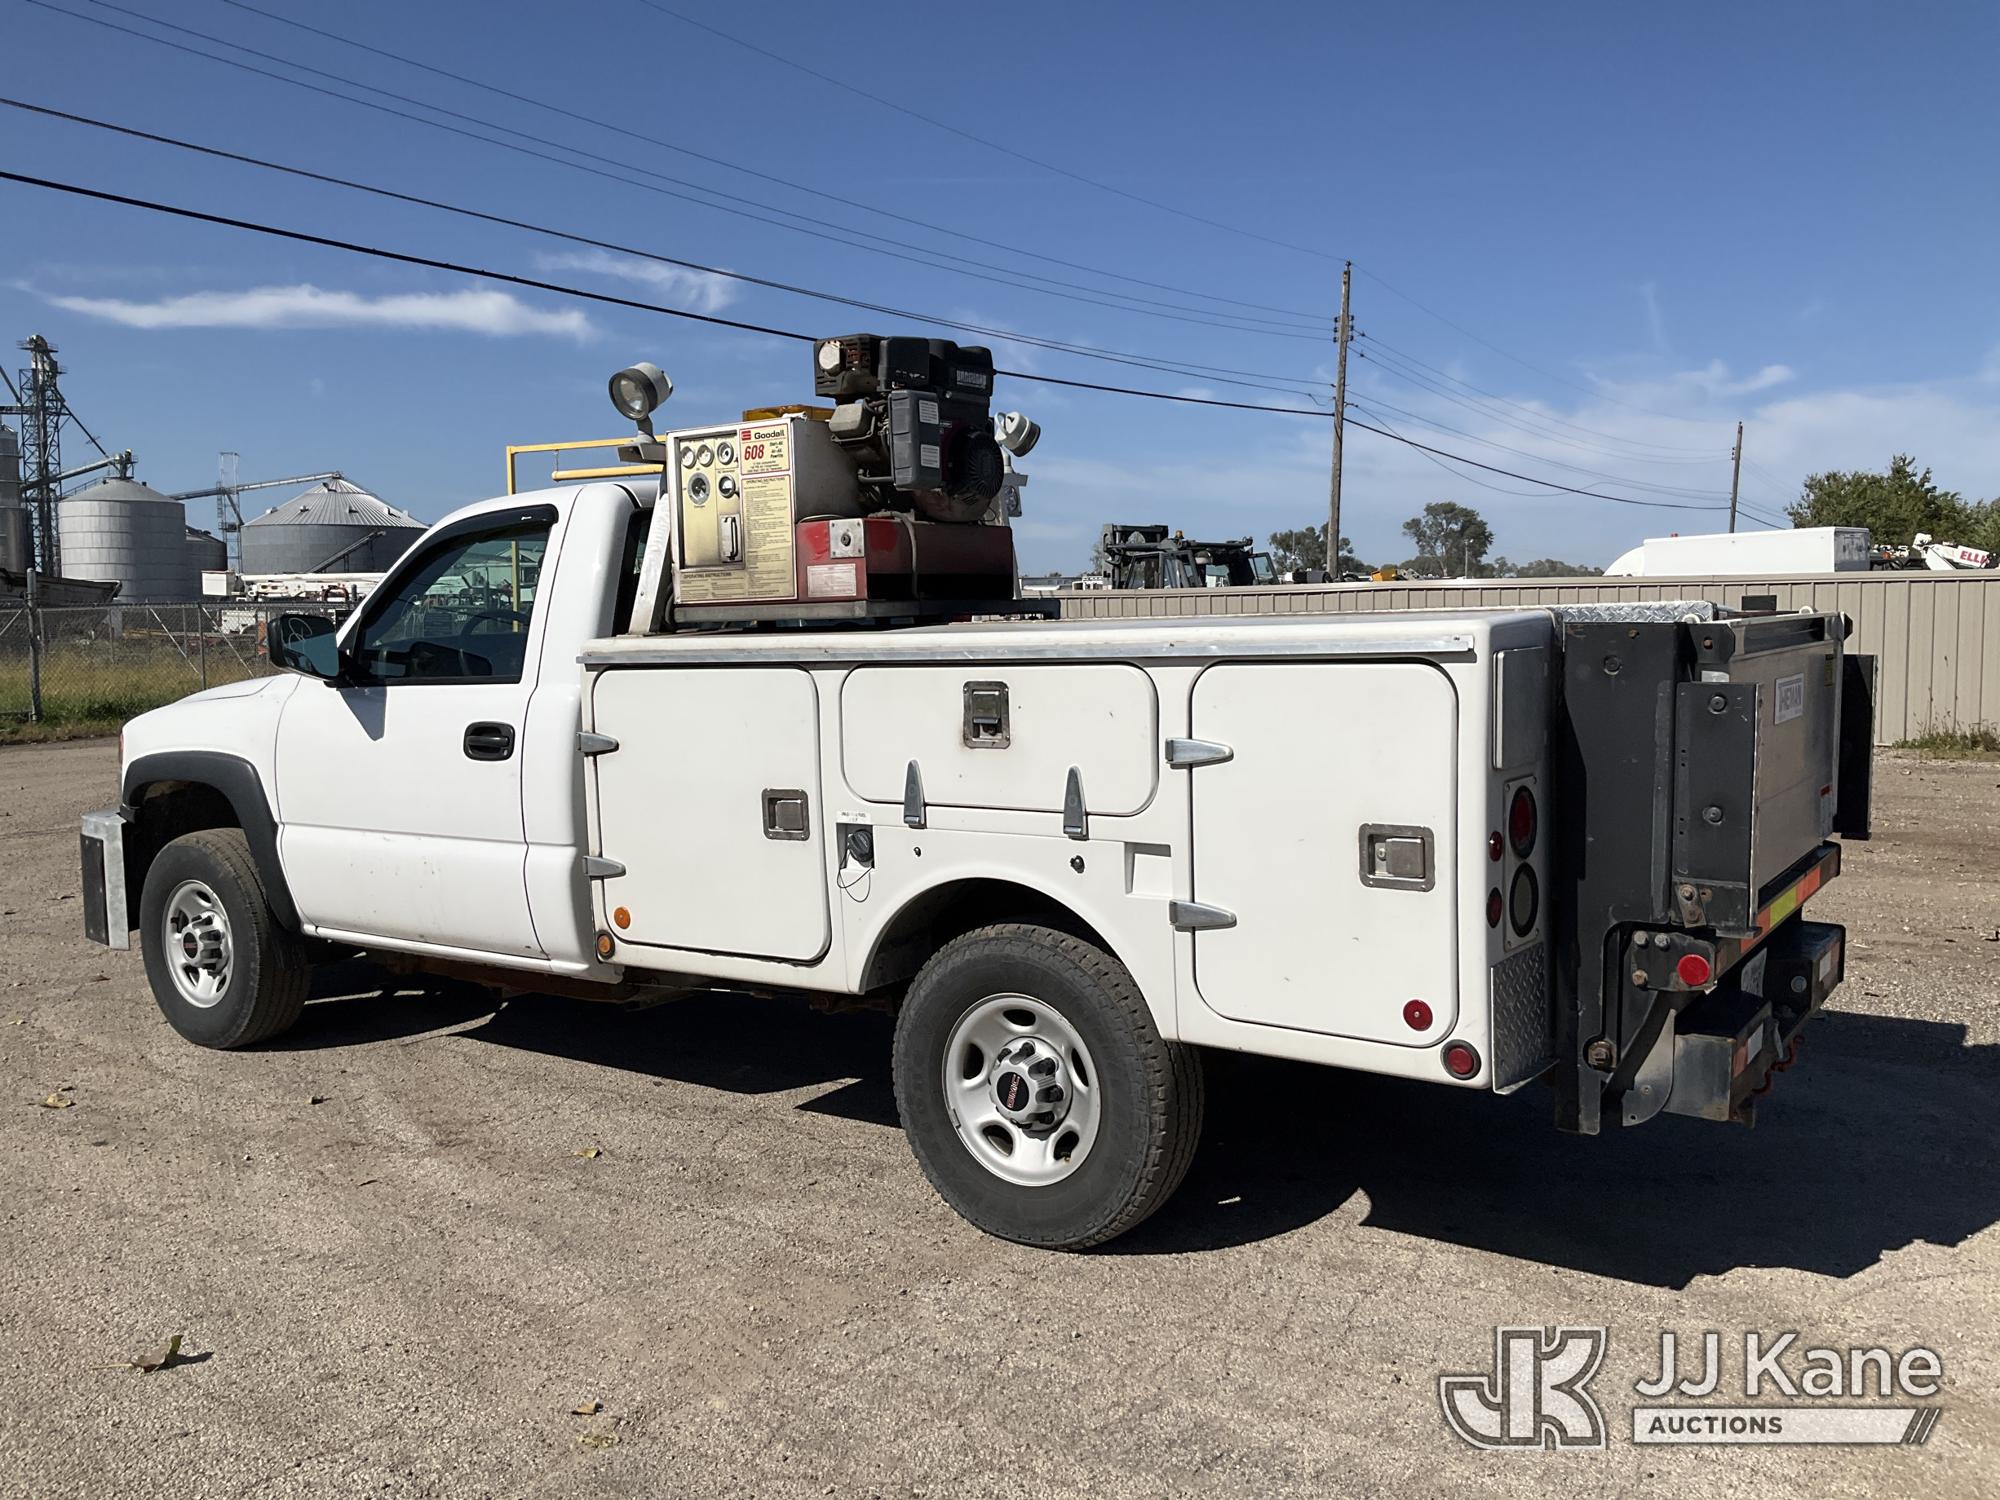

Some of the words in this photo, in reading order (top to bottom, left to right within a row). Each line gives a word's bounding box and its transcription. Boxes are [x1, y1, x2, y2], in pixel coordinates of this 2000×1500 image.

[754, 430, 785, 439] Goodall
[744, 444, 764, 460] 608
[1007, 1074, 1020, 1108] GMC
